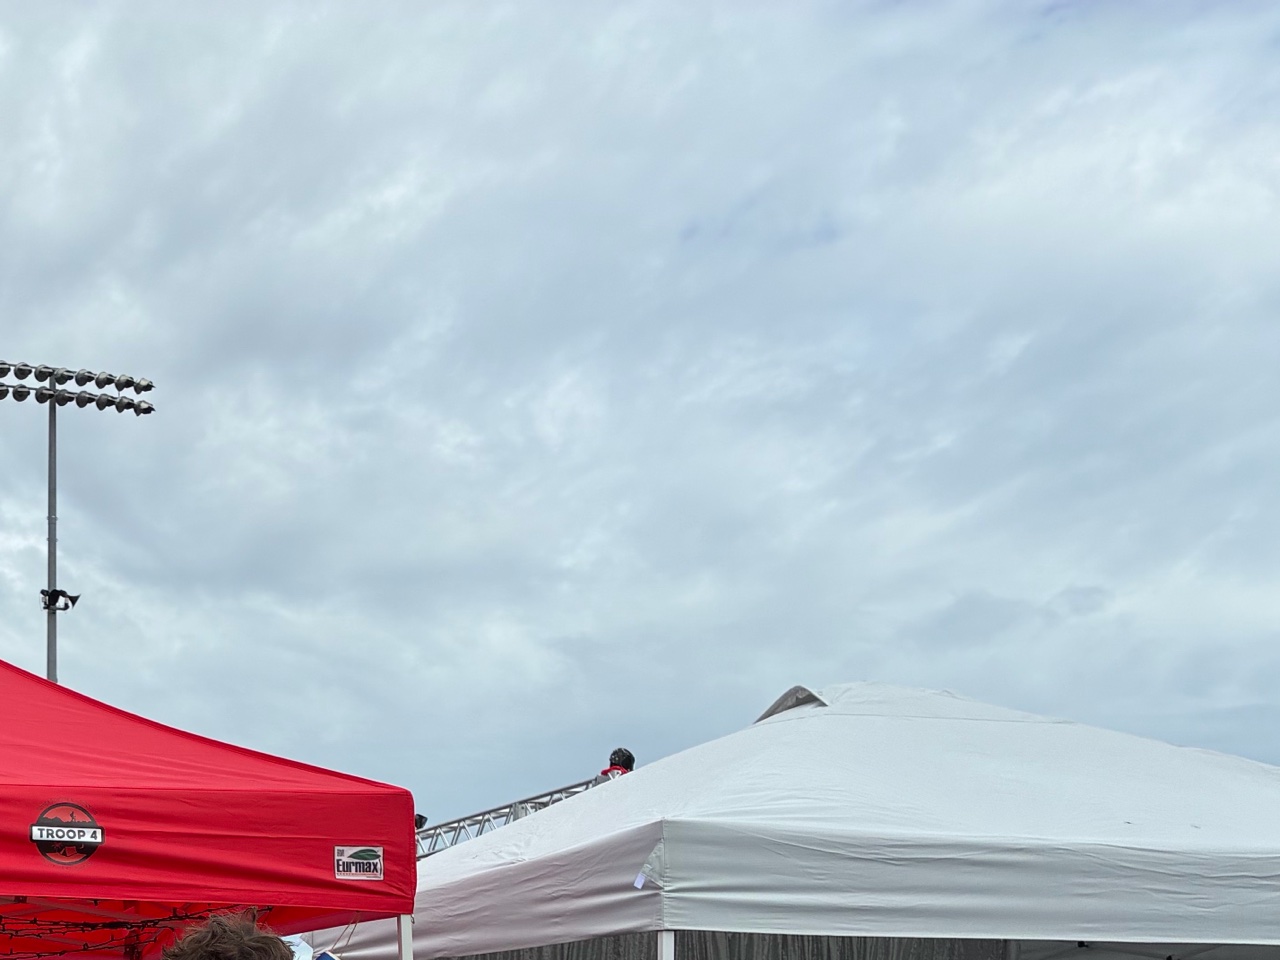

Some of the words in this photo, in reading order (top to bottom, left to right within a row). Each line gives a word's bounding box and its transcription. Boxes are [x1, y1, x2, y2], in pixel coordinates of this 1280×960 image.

[38, 828, 85, 839] TROOP
[91, 831, 97, 840] 4
[336, 859, 378, 873] Eurmax
